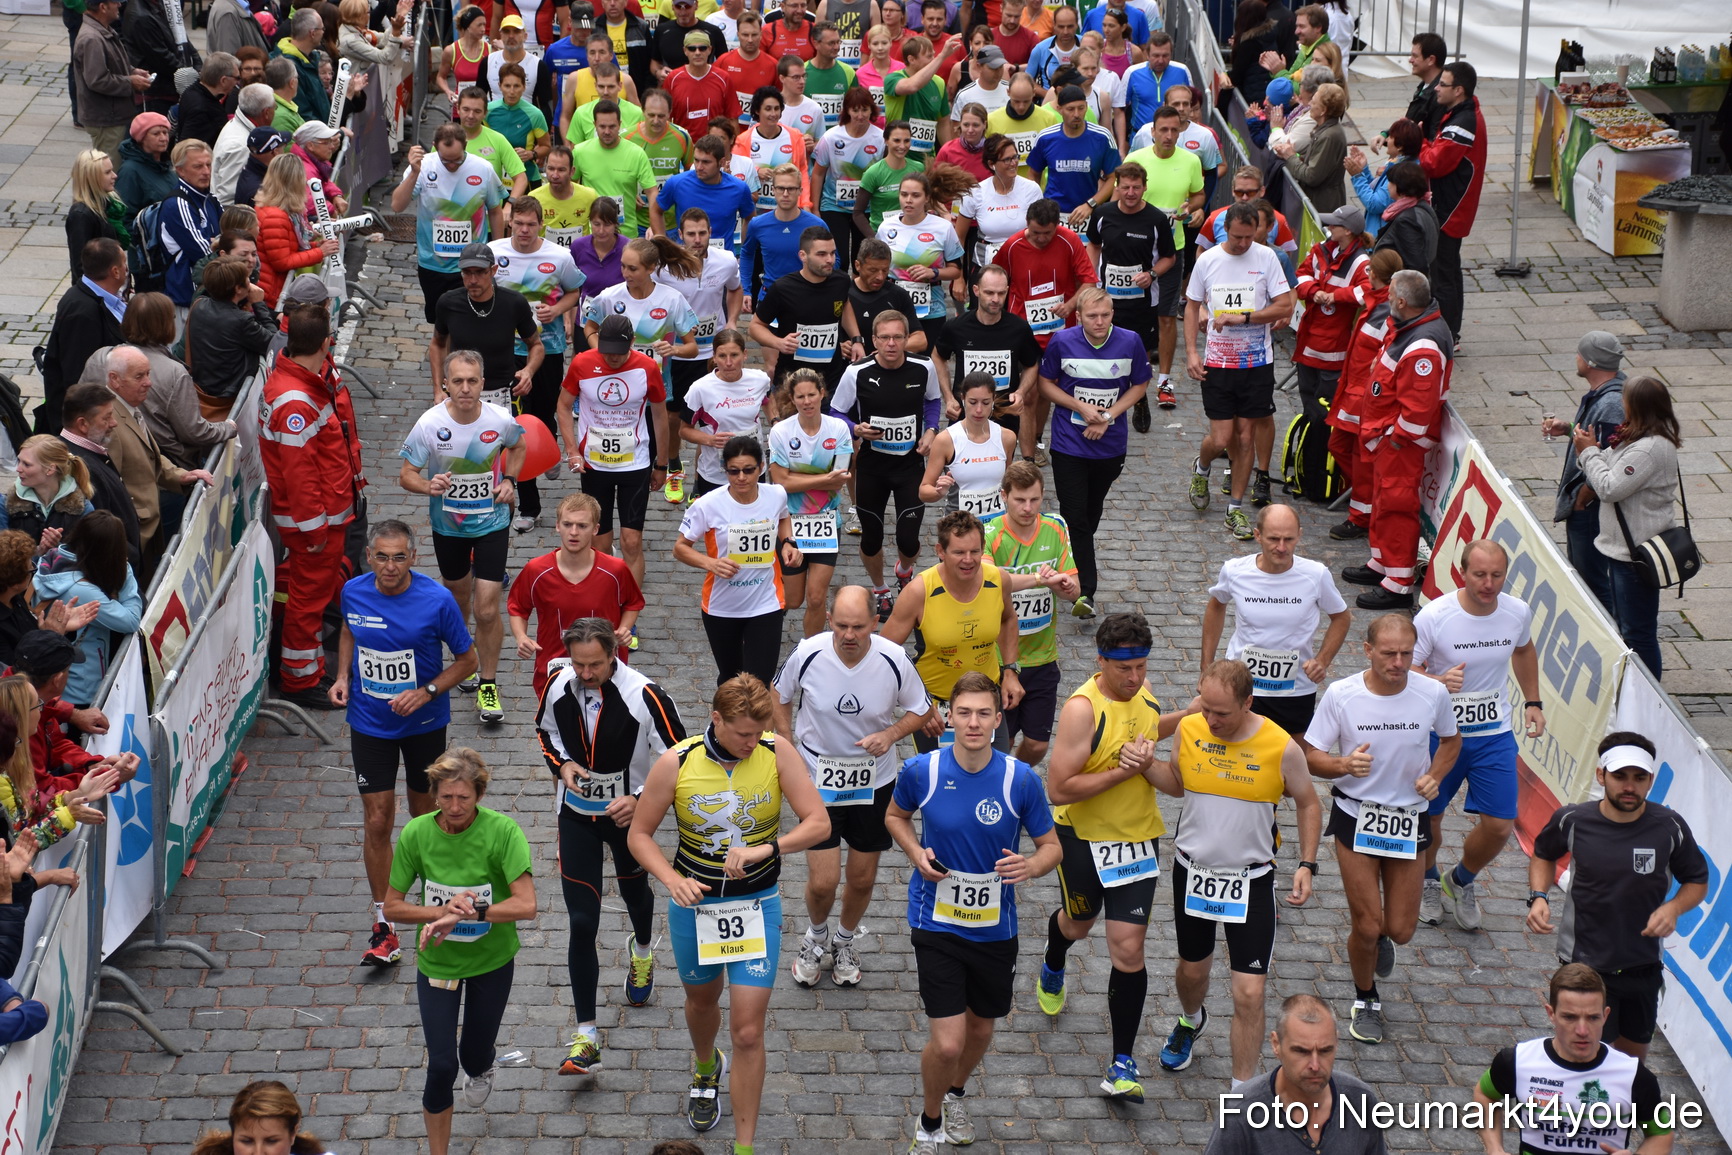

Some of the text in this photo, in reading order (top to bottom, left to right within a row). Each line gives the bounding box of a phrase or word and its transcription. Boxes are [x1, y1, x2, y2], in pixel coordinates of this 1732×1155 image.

[837, 46, 860, 58] 176
[910, 126, 936, 142] 2368
[1017, 138, 1034, 154] 68
[1056, 159, 1091, 169] HUBER
[840, 188, 861, 201] 245
[315, 197, 330, 224] BMW
[436, 228, 469, 244] 2802
[556, 235, 572, 248] 84
[1108, 272, 1134, 288] 259
[1224, 292, 1243, 308] 44
[1030, 306, 1057, 324] 231
[800, 333, 836, 349] 3074
[968, 360, 1008, 376] 2236
[880, 425, 913, 442] 063
[601, 437, 621, 454] 95
[881, 442, 906, 451] Michael
[599, 454, 624, 463] Michael
[971, 455, 1001, 465] KLEBL
[461, 475, 487, 483] Neumarkt
[447, 481, 490, 500] 2233
[976, 489, 999, 499] Neumarkt
[455, 501, 481, 510] Johann
[963, 494, 1002, 512] 2174
[747, 526, 772, 535] Neumarkt
[793, 520, 833, 538] 2125
[738, 533, 771, 553] 316
[801, 540, 827, 549] Melanie
[745, 555, 763, 564] Jutta
[728, 577, 765, 588] SIEMENS
[1024, 591, 1049, 599] Neumarkt
[1244, 595, 1303, 605] www.hasit.de
[1020, 620, 1041, 629] Arthur
[1453, 638, 1512, 650] www.hasit.de
[375, 654, 404, 663] Neumarkt
[1243, 648, 1291, 661] PARTL Neumarkt
[363, 659, 411, 682] 3109
[1246, 657, 1294, 679] 2507
[369, 681, 398, 693] Ernst
[1253, 679, 1284, 690] Manfred
[1451, 694, 1494, 704] ARTL Neumarkt
[1452, 700, 1499, 724] 2508
[1357, 721, 1420, 732] www.hasit.de
[1208, 742, 1227, 751] UFER
[818, 758, 838, 768] PARTL
[822, 767, 871, 789] 2349
[834, 791, 856, 801] Josef
[1362, 811, 1413, 838] 2509
[1366, 837, 1405, 851] Wolfgang
[1099, 841, 1149, 867] 2711
[1117, 864, 1141, 878] Alfred
[1189, 863, 1241, 878] PARTL Neumarkt
[961, 877, 994, 885] Neumarkt
[1192, 874, 1244, 901] 2678
[426, 885, 447, 898] PARTL
[951, 884, 991, 908] 136
[718, 905, 751, 915] Neumarkt
[953, 908, 982, 921] Martin
[1203, 902, 1225, 915] Jockl
[717, 914, 745, 941] 93
[720, 944, 745, 956] Klaus
[1543, 1133, 1599, 1150] Fürth
